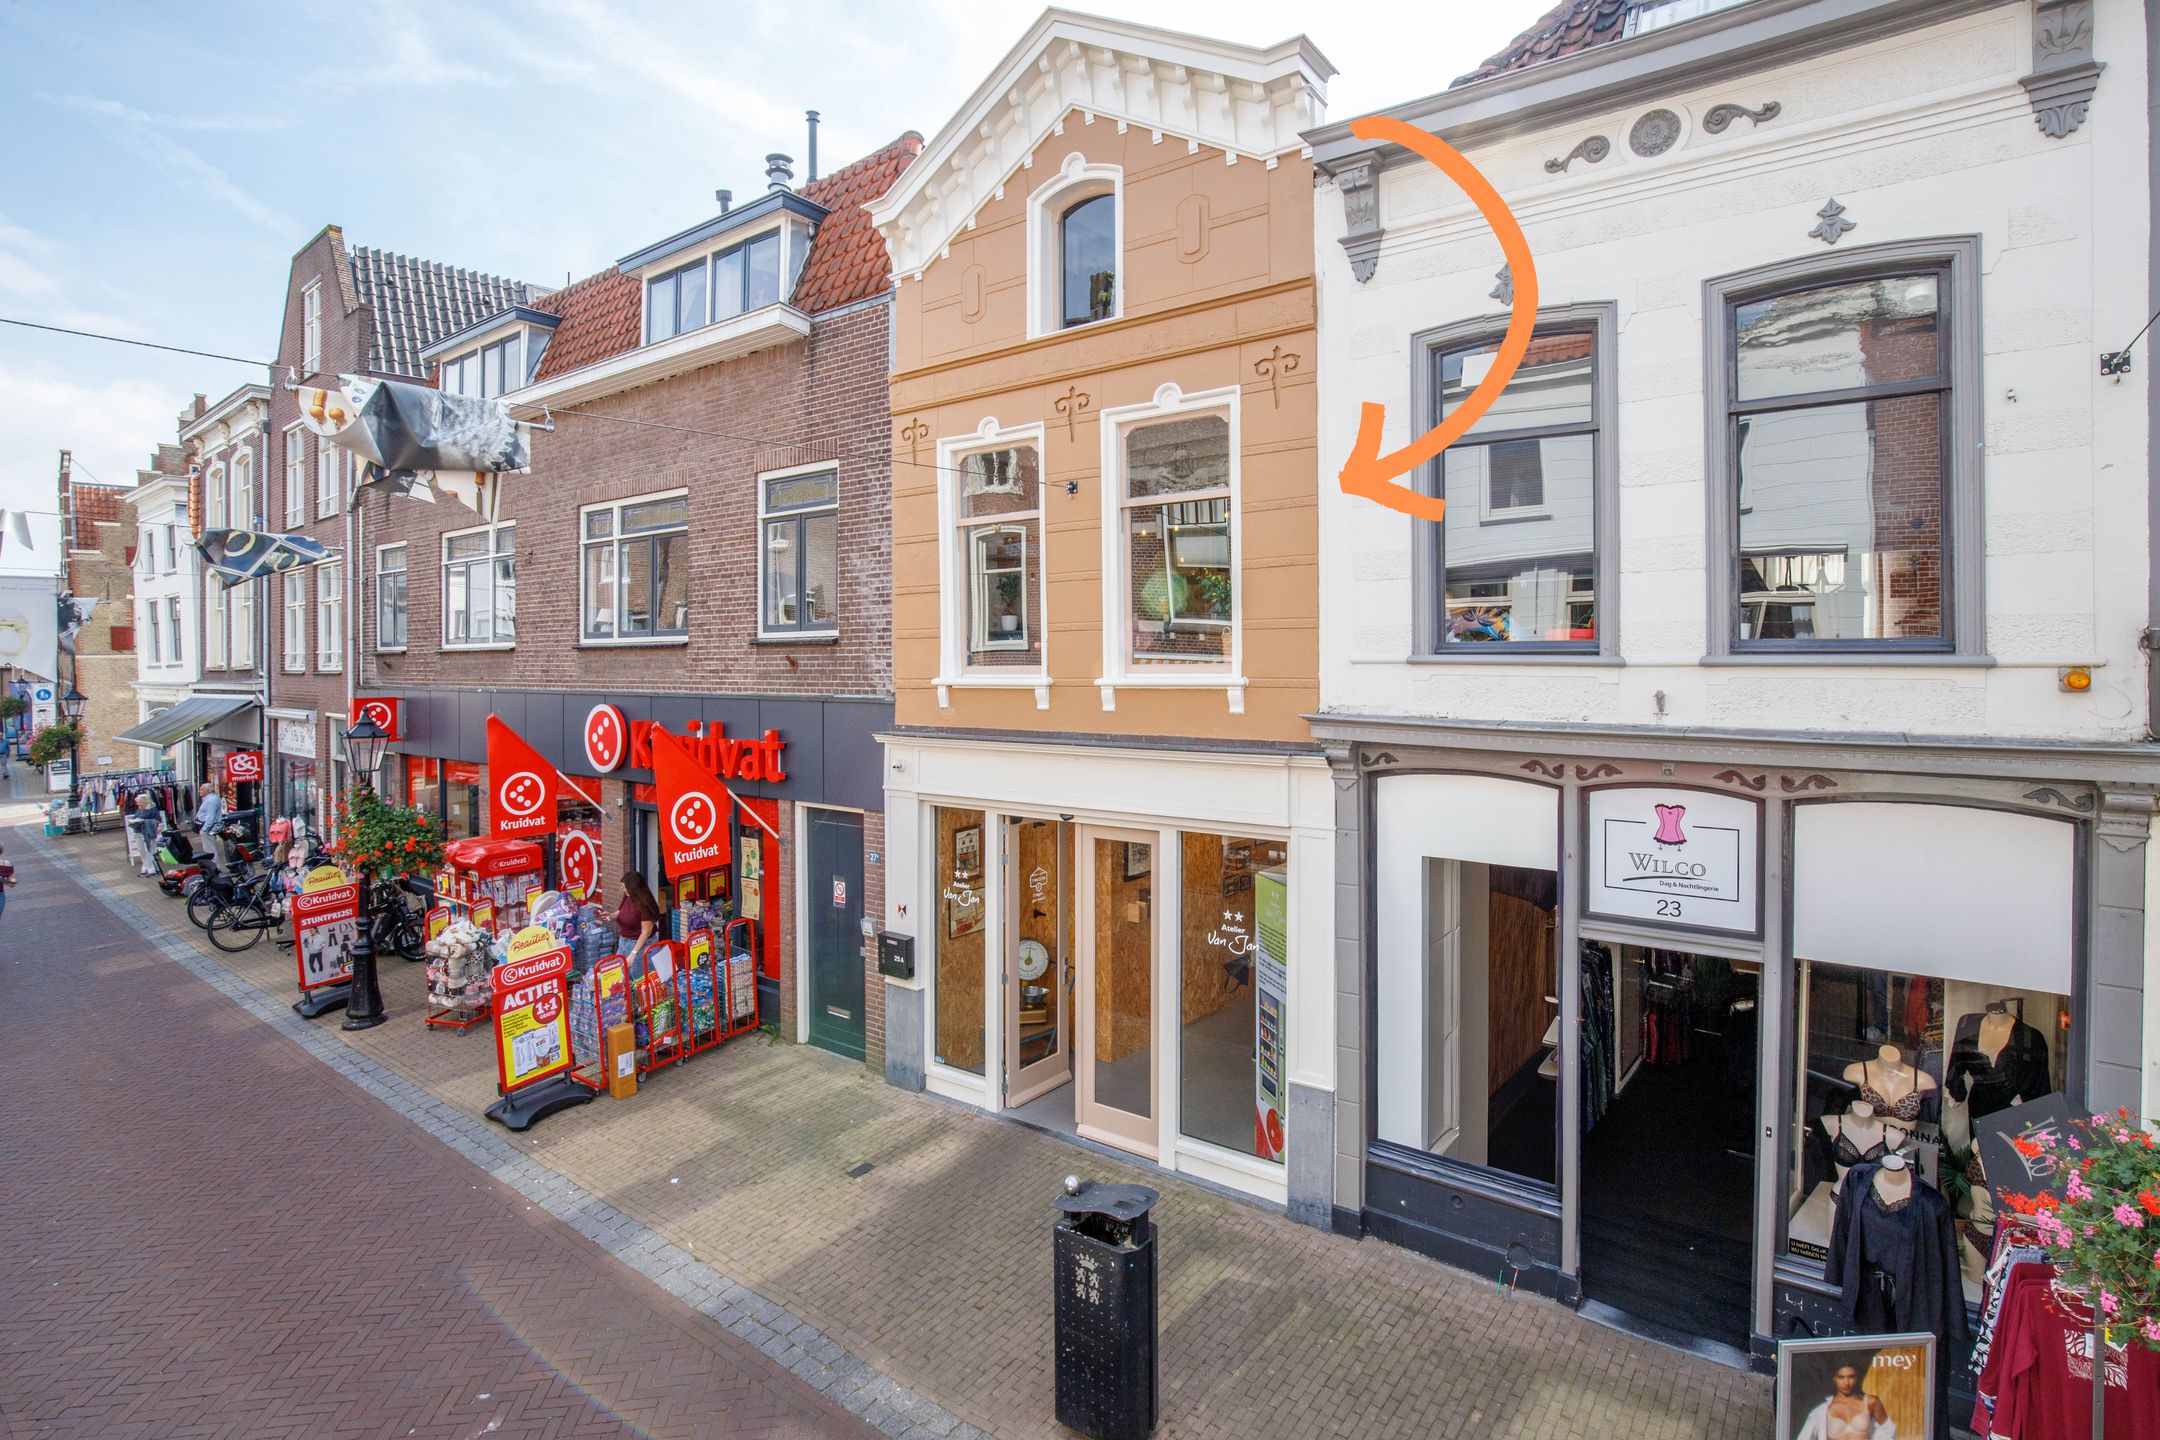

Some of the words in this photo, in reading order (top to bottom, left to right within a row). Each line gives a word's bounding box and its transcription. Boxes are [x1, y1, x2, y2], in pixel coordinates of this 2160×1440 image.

[630, 719, 788, 783] Kidvat
[500, 815, 546, 831] Kruidvat
[499, 856, 527, 868] Kruidvat
[674, 844, 719, 864] Kruidvat
[1629, 852, 1707, 877] WILCO
[953, 881, 970, 889] Atelier
[1659, 881, 1672, 889] Dag
[1678, 882, 1719, 892] Nachtlingerie
[312, 889, 350, 904] Kruidvat
[943, 887, 957, 900] Van
[958, 890, 979, 906] Jan
[301, 908, 353, 926] STUNTPRIJS!
[1656, 899, 1682, 917] 23
[1221, 923, 1246, 934] Atelier
[1208, 930, 1226, 945] Van
[1228, 935, 1259, 955] Jan
[517, 956, 561, 977] Kruidvat
[503, 978, 559, 1011] ACTIE!
[535, 997, 558, 1015] 1+1
[1872, 1353, 1917, 1370] mey
